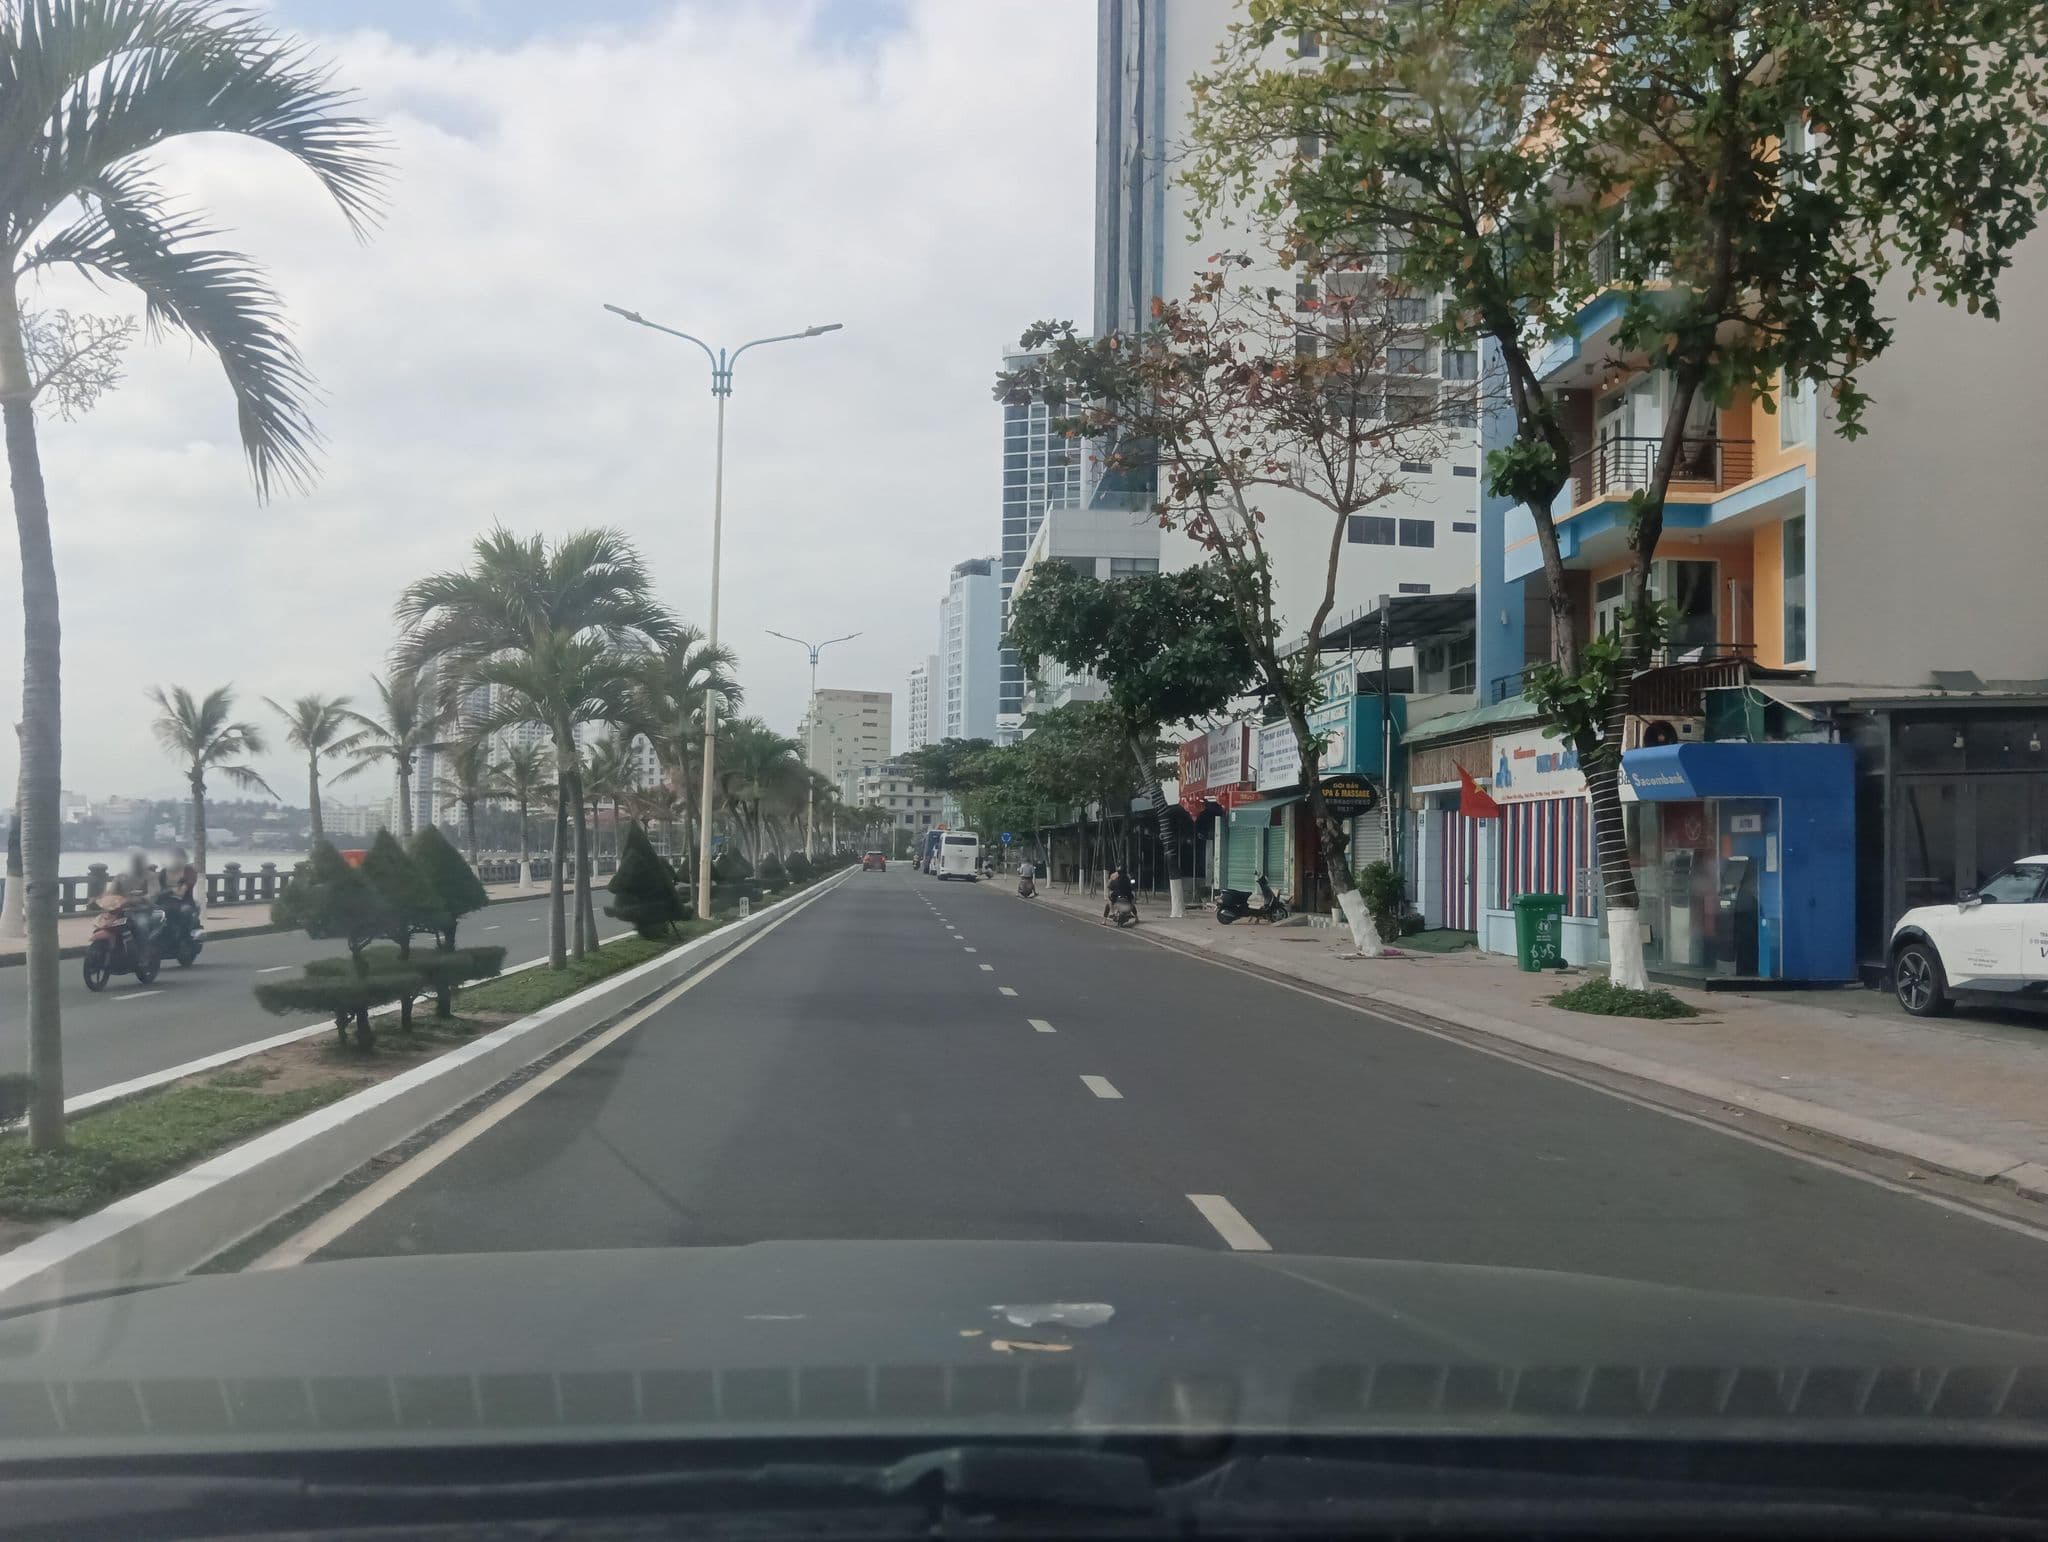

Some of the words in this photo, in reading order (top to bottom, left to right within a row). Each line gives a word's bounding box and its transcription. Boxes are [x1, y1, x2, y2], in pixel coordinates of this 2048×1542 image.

[1335, 671, 1353, 698] SPA
[1185, 755, 1207, 785] SAIGON
[1631, 771, 1685, 787] Sacombank
[1341, 789, 1370, 798] MASSAGE
